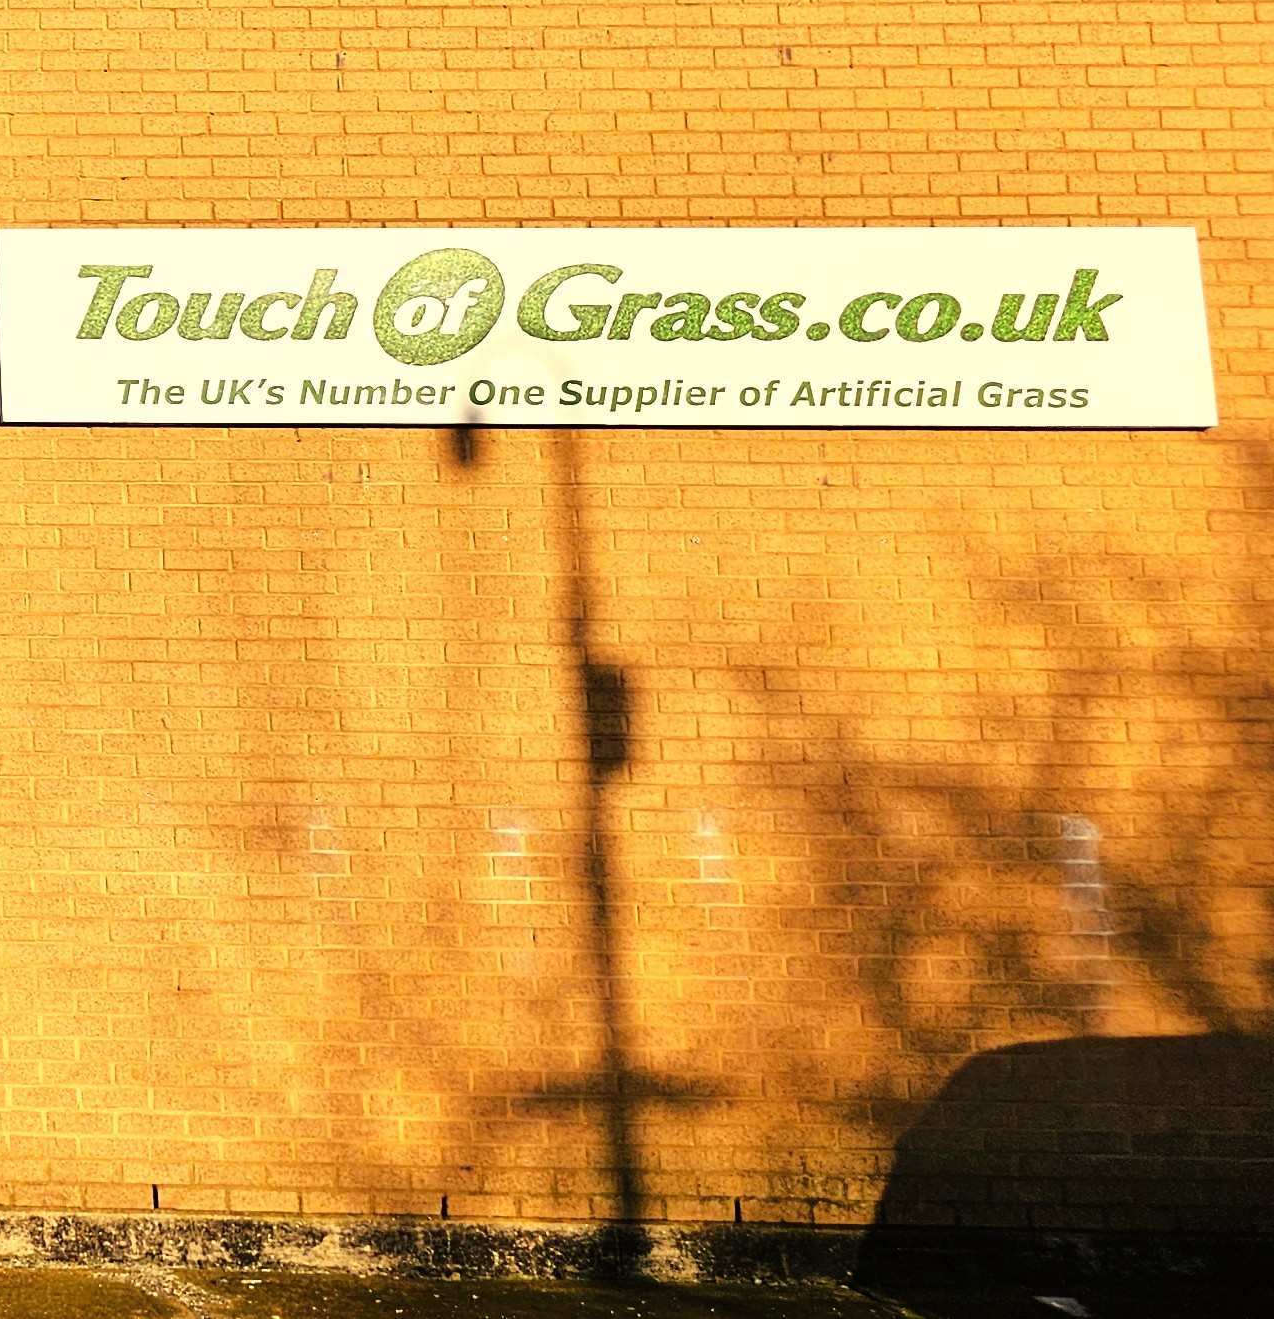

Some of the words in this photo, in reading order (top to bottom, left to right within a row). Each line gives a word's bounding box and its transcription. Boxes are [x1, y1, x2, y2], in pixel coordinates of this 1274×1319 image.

[76, 263, 356, 342] Touch
[392, 276, 489, 337] of
[515, 264, 1124, 344] Grass.co.uk
[116, 378, 185, 405] The
[200, 378, 285, 406] UK's
[299, 378, 456, 406] Number
[468, 379, 545, 406] One
[558, 379, 726, 413] Supplier
[738, 379, 782, 408] of
[789, 379, 962, 408] Artificial
[977, 381, 1089, 409] Grass
